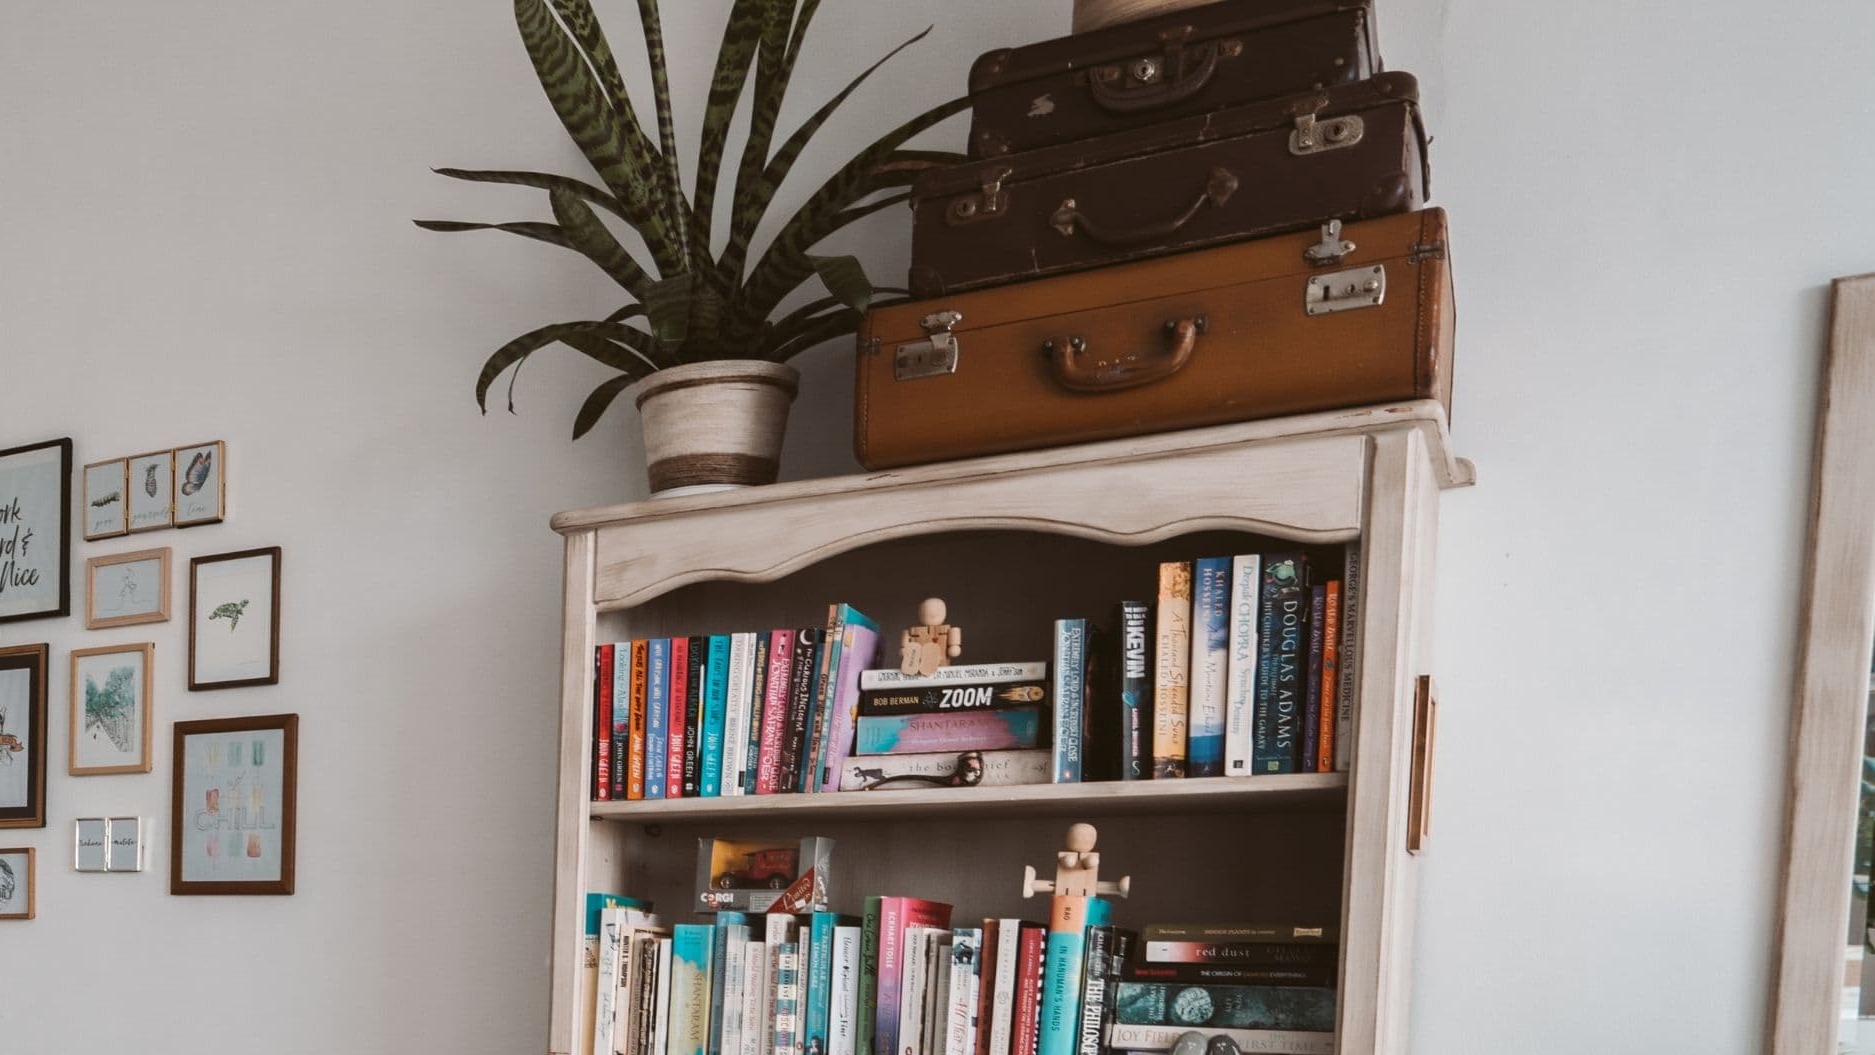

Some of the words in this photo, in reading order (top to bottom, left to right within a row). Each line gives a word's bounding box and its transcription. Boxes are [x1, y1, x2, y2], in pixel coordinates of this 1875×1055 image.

[22, 527, 34, 557] &
[0, 560, 40, 593] Nice
[1238, 565, 1253, 602] Deepak
[1348, 553, 1359, 601] GEORGE'S
[1202, 568, 1212, 624] HOSSEINI
[1214, 570, 1226, 617] KHALED
[1171, 610, 1183, 624] A
[1313, 597, 1323, 627] ROALD
[1327, 593, 1337, 625] ROALD
[1236, 602, 1251, 661] CHOPRA
[1280, 600, 1298, 682] DOUGLAS
[1312, 628, 1322, 655] DAHL
[1325, 626, 1336, 652] DAHL
[1343, 604, 1356, 670] MARVELLOUS
[732, 640, 742, 674] DARING
[1071, 627, 1081, 670] EXTREMELY
[1126, 627, 1145, 678] KEVIN
[1160, 634, 1169, 680] KHALED
[1170, 626, 1187, 668] Thousand
[769, 658, 781, 705] JONATHAN
[778, 658, 790, 699] EXTREMELY
[1070, 671, 1080, 692] LOUD
[1261, 660, 1270, 688] GUIDE
[873, 697, 888, 706] BOB
[889, 696, 919, 706] BERMAN
[939, 687, 994, 708] ZOOM
[1169, 670, 1185, 716] Splendid
[1259, 689, 1269, 699] TO
[1340, 671, 1352, 722] MEDICINE
[777, 701, 787, 721] LOUD
[795, 693, 808, 732] INCIDENT
[1159, 683, 1167, 736] HOSSEINI
[1259, 702, 1268, 717] THE
[1277, 689, 1293, 748] ADAMS
[686, 726, 695, 747] JOHN
[764, 707, 779, 745] SAFRAN
[1170, 719, 1184, 745] Suns
[1257, 719, 1267, 750] GALAXY
[599, 739, 609, 756] JOHN
[615, 741, 623, 759] JOHN
[633, 734, 642, 752] JOHN
[671, 733, 682, 752] JOHN
[707, 731, 718, 750] JOHN
[1068, 738, 1077, 762] CLOSE
[599, 758, 608, 783] GREEN
[633, 754, 641, 779] GREEN
[671, 754, 681, 779] GREEN
[685, 751, 694, 777] GREEN
[706, 753, 718, 778] GREEN
[725, 747, 734, 779] BROWN
[761, 747, 775, 781] FOER
[909, 761, 930, 772] the
[769, 767, 780, 791] CLOSE
[193, 806, 277, 832] CHILL
[700, 893, 734, 903] CORGI
[1063, 906, 1071, 920] RAO
[887, 912, 897, 946] ECKHART
[886, 947, 895, 968] TOLLE
[1059, 945, 1067, 955] IN
[1195, 946, 1216, 957] red
[1221, 948, 1250, 957] dust
[1054, 957, 1066, 1003] HANUMAN'S
[1086, 978, 1105, 1003] THE
[690, 971, 703, 1041] SHANTARAM
[1051, 1006, 1062, 1032] HANDS
[954, 1022, 965, 1044] That
[1117, 1030, 1141, 1042] JOY
